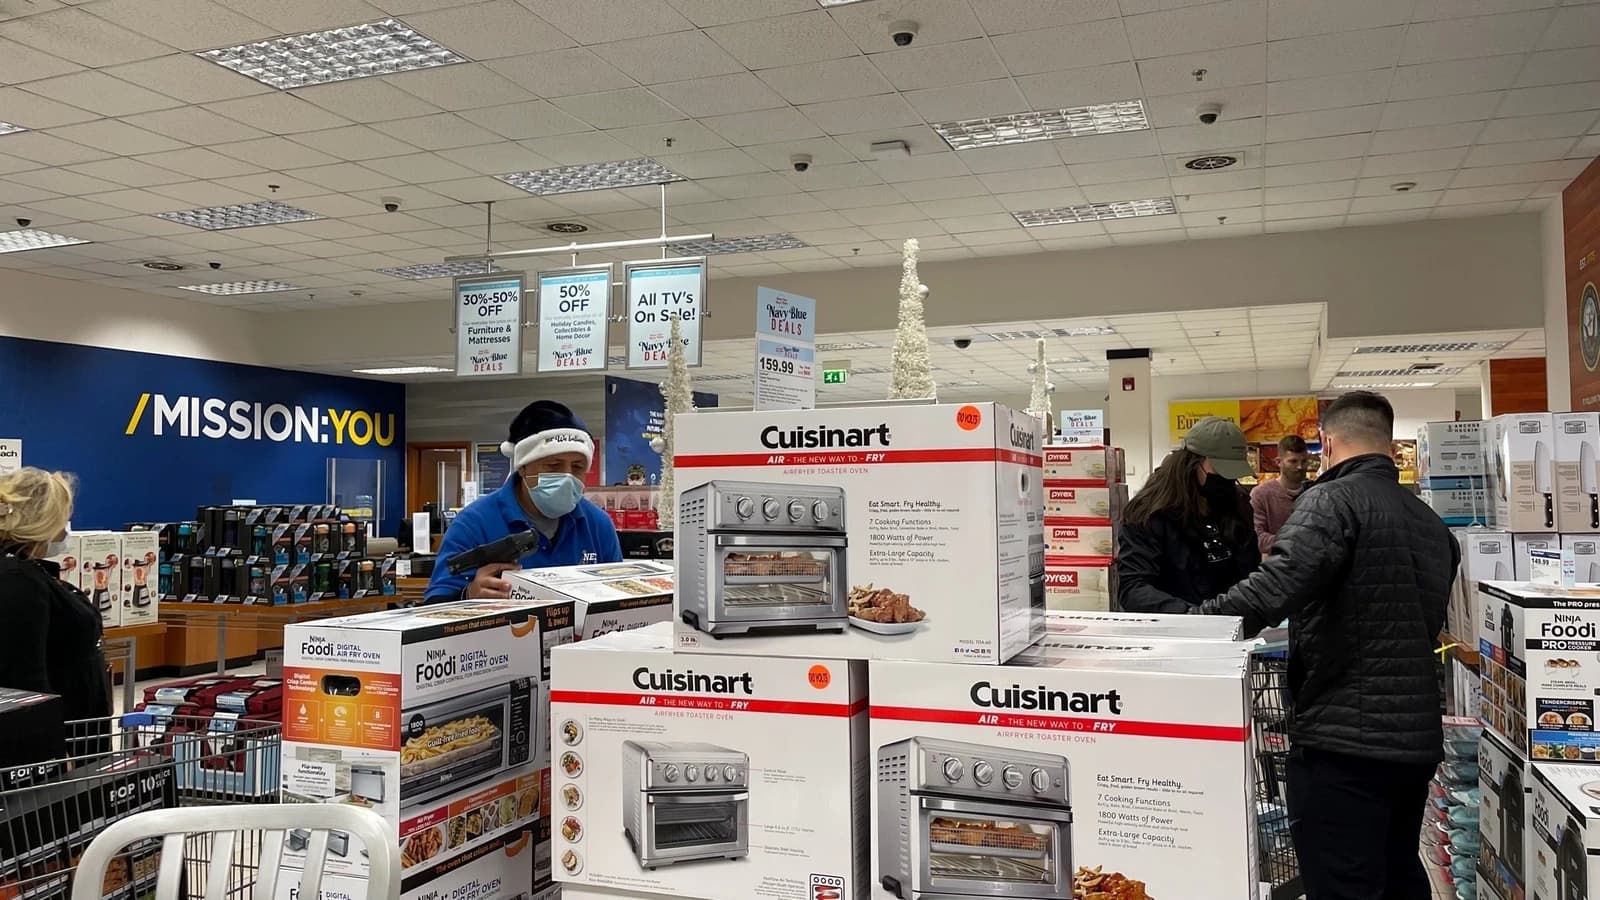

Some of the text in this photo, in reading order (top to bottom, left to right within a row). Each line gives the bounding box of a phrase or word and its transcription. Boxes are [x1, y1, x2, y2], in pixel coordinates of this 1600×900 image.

[559, 284, 590, 298] 50%
[463, 290, 518, 306] 30%-50%
[638, 291, 694, 306] All TV's
[478, 304, 503, 316] OFF
[559, 299, 590, 312] OFF
[766, 303, 807, 321] Navy Blue
[634, 310, 656, 323] On
[467, 324, 512, 335] Furniture &
[771, 318, 802, 336] DEALS
[468, 335, 510, 344] Mattresses
[552, 347, 592, 359] Navy Blue
[638, 341, 664, 352] Navy
[470, 353, 508, 364] Navy Blue
[556, 357, 587, 367] DEALS
[644, 351, 666, 360] DEA
[474, 362, 503, 372] DEALS
[759, 356, 794, 374] 159.99
[125, 393, 395, 448] /MISSION:YOU
[760, 423, 890, 449] Cuisinart
[1010, 422, 1034, 451] Cuisinart
[767, 455, 785, 464] AIR
[793, 456, 806, 464] THE
[808, 456, 826, 464] NEW
[828, 455, 845, 463] WAY
[865, 453, 886, 462] FRY
[1051, 491, 1073, 499] pyrex
[868, 500, 879, 508] Eat
[903, 500, 914, 508] Fry
[874, 518, 900, 526] Cooking
[906, 534, 912, 542] of
[1054, 529, 1076, 538] pyrex
[906, 550, 934, 558] Capacity
[1554, 613, 1582, 624] NINJA
[1541, 622, 1596, 638] Foodi
[309, 634, 326, 644] NINJA
[1541, 640, 1567, 650] PRO
[301, 642, 334, 656] Foodi
[336, 643, 361, 652] DIGITAL
[362, 652, 380, 660] OVEN
[426, 649, 446, 662] NINJA
[460, 649, 488, 663] DIGITAL
[416, 656, 456, 683] Foodi
[460, 654, 508, 673] AIR FRY OVEN
[632, 666, 752, 694] Cuisinart
[639, 696, 656, 705] AIR
[663, 698, 676, 706] THE
[678, 699, 694, 707] NEW
[696, 700, 712, 708] WAY
[730, 701, 749, 710] FRY
[970, 681, 1121, 715] Cuisinart
[654, 710, 684, 718] AIRFRYER
[686, 712, 714, 720] TOASTER
[410, 720, 423, 728] 1800
[978, 714, 1116, 732] AIR THE NEW WAY TO FRY
[996, 730, 1096, 744] AIRFRYER TOASTER OVEN
[1097, 774, 1108, 782] Eat
[1110, 775, 1136, 784] Smart.
[1137, 777, 1150, 786] Fry
[1151, 778, 1184, 789] Healthy.
[110, 782, 135, 802] POP
[141, 776, 156, 793] 10
[1104, 794, 1134, 805] Cooking
[1135, 797, 1171, 807] Functions
[1098, 811, 1174, 824] 1800 Watts of Power
[1098, 828, 1140, 840] Extra-Large
[1142, 832, 1174, 844] Capacity
[452, 879, 480, 899] DIGITAL
[481, 876, 502, 893] OVEN
